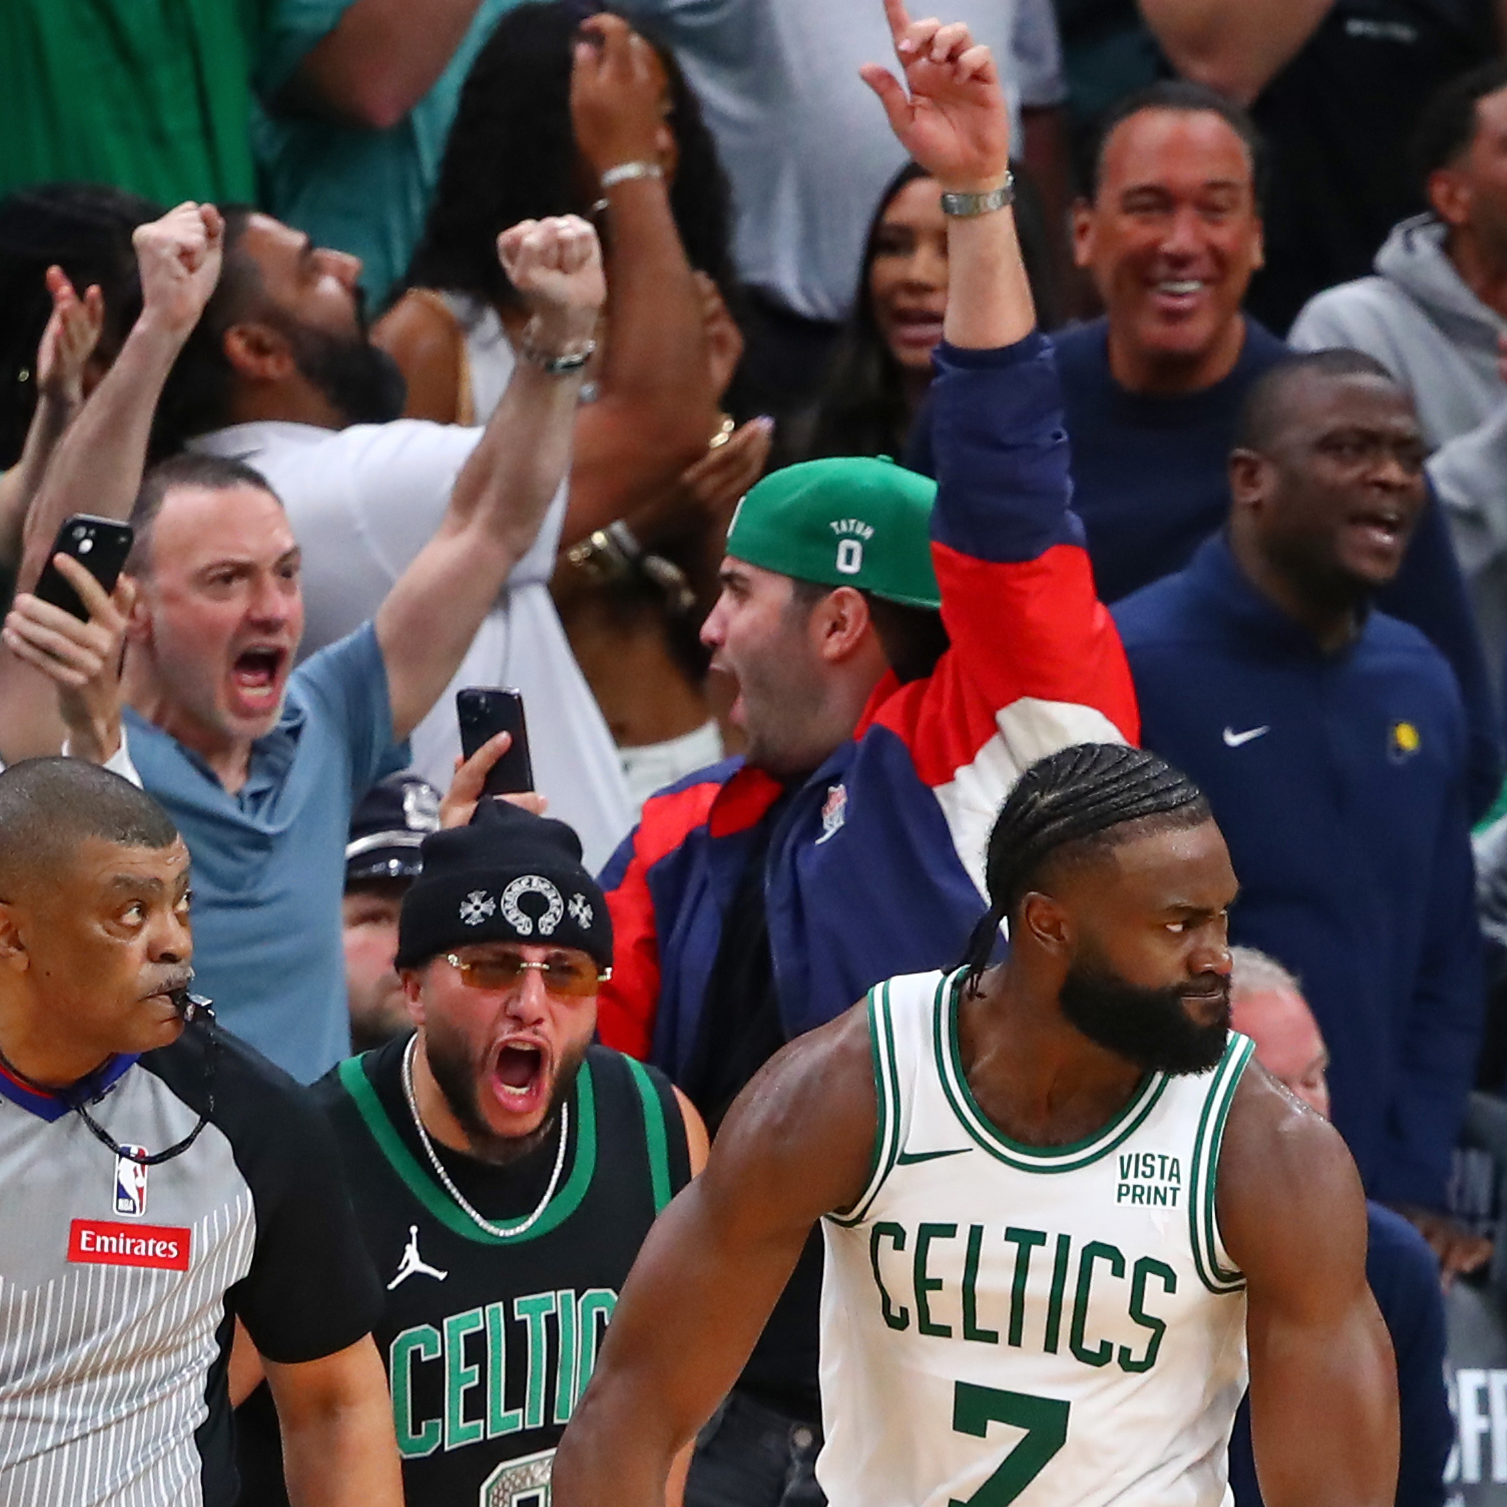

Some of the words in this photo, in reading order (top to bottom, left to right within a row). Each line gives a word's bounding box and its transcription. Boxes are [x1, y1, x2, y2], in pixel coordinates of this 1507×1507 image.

[836, 538, 863, 575] 0
[1119, 1152, 1181, 1185] VISTA
[1116, 1183, 1181, 1207] PRINT
[80, 1229, 179, 1259] Emirates
[869, 1221, 1177, 1373] CELTICS
[389, 1288, 619, 1460] CELTIC
